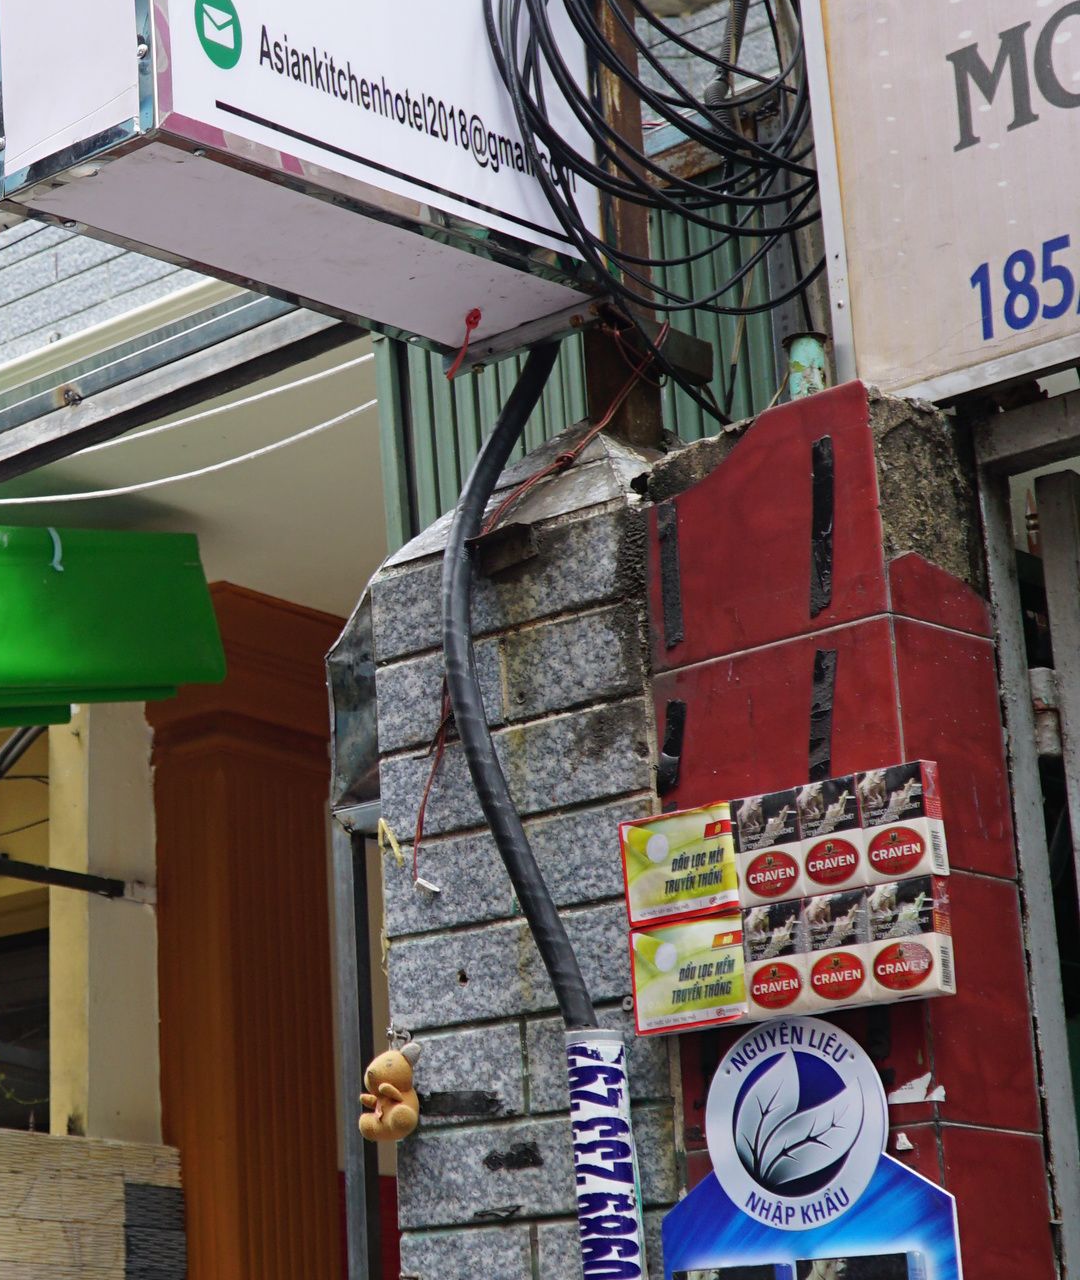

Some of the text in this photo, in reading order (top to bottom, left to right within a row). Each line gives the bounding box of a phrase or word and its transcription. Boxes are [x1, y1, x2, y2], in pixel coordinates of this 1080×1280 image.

[970, 234, 1080, 341] 185
[871, 842, 921, 861] CRAVEN
[808, 854, 855, 872] CRAVEN
[749, 867, 795, 884] CRAVEN
[813, 968, 862, 986] CRAVEN
[877, 960, 929, 976] CRAVEN
[753, 978, 799, 995] CRAVEN
[730, 1023, 849, 1073] NGUYÊN LIỆU
[745, 1187, 850, 1227] NHẬP KHẨU
